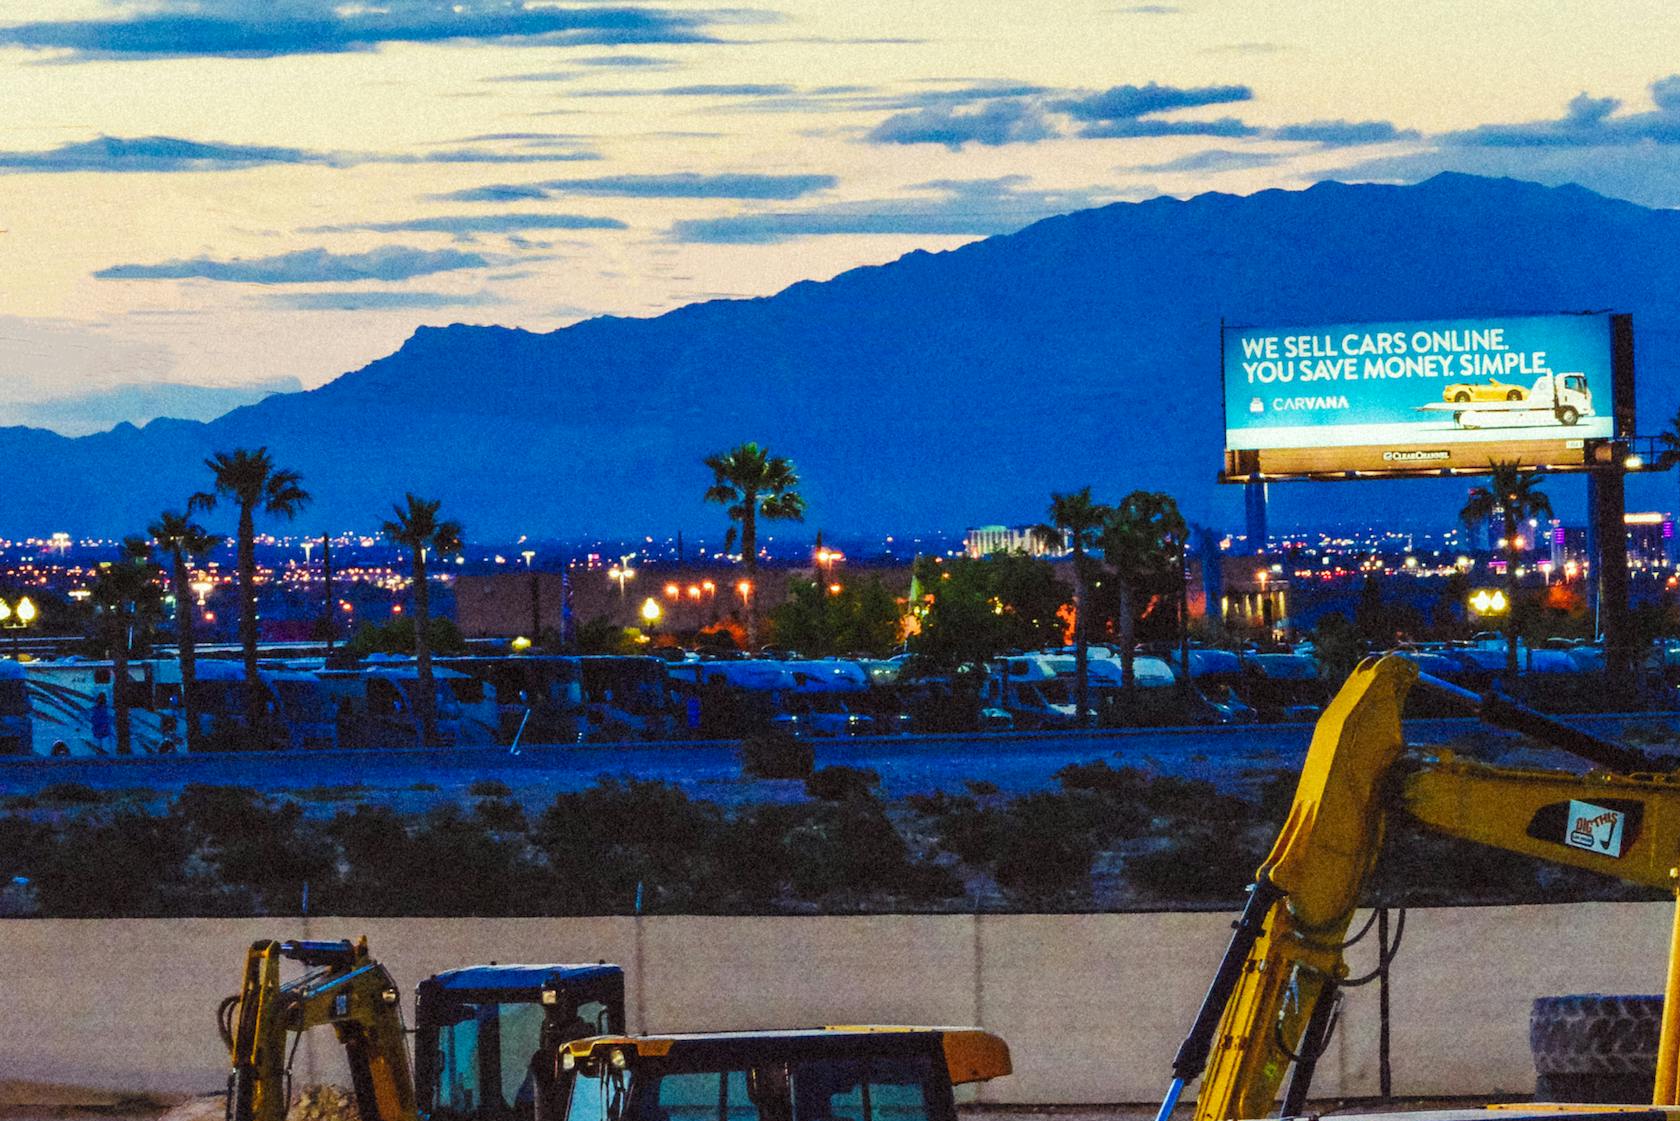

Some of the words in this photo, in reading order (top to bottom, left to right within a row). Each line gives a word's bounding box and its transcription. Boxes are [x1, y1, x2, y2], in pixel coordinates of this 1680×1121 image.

[1241, 337, 1279, 359] WE
[1284, 335, 1338, 358] SELL
[1342, 332, 1407, 355] CARS
[1412, 328, 1509, 353] ONLINE.
[1242, 361, 1294, 384] YOU
[1299, 358, 1359, 382] SAVE
[1363, 354, 1454, 379] MONEY.
[1272, 396, 1349, 411] CARVANA
